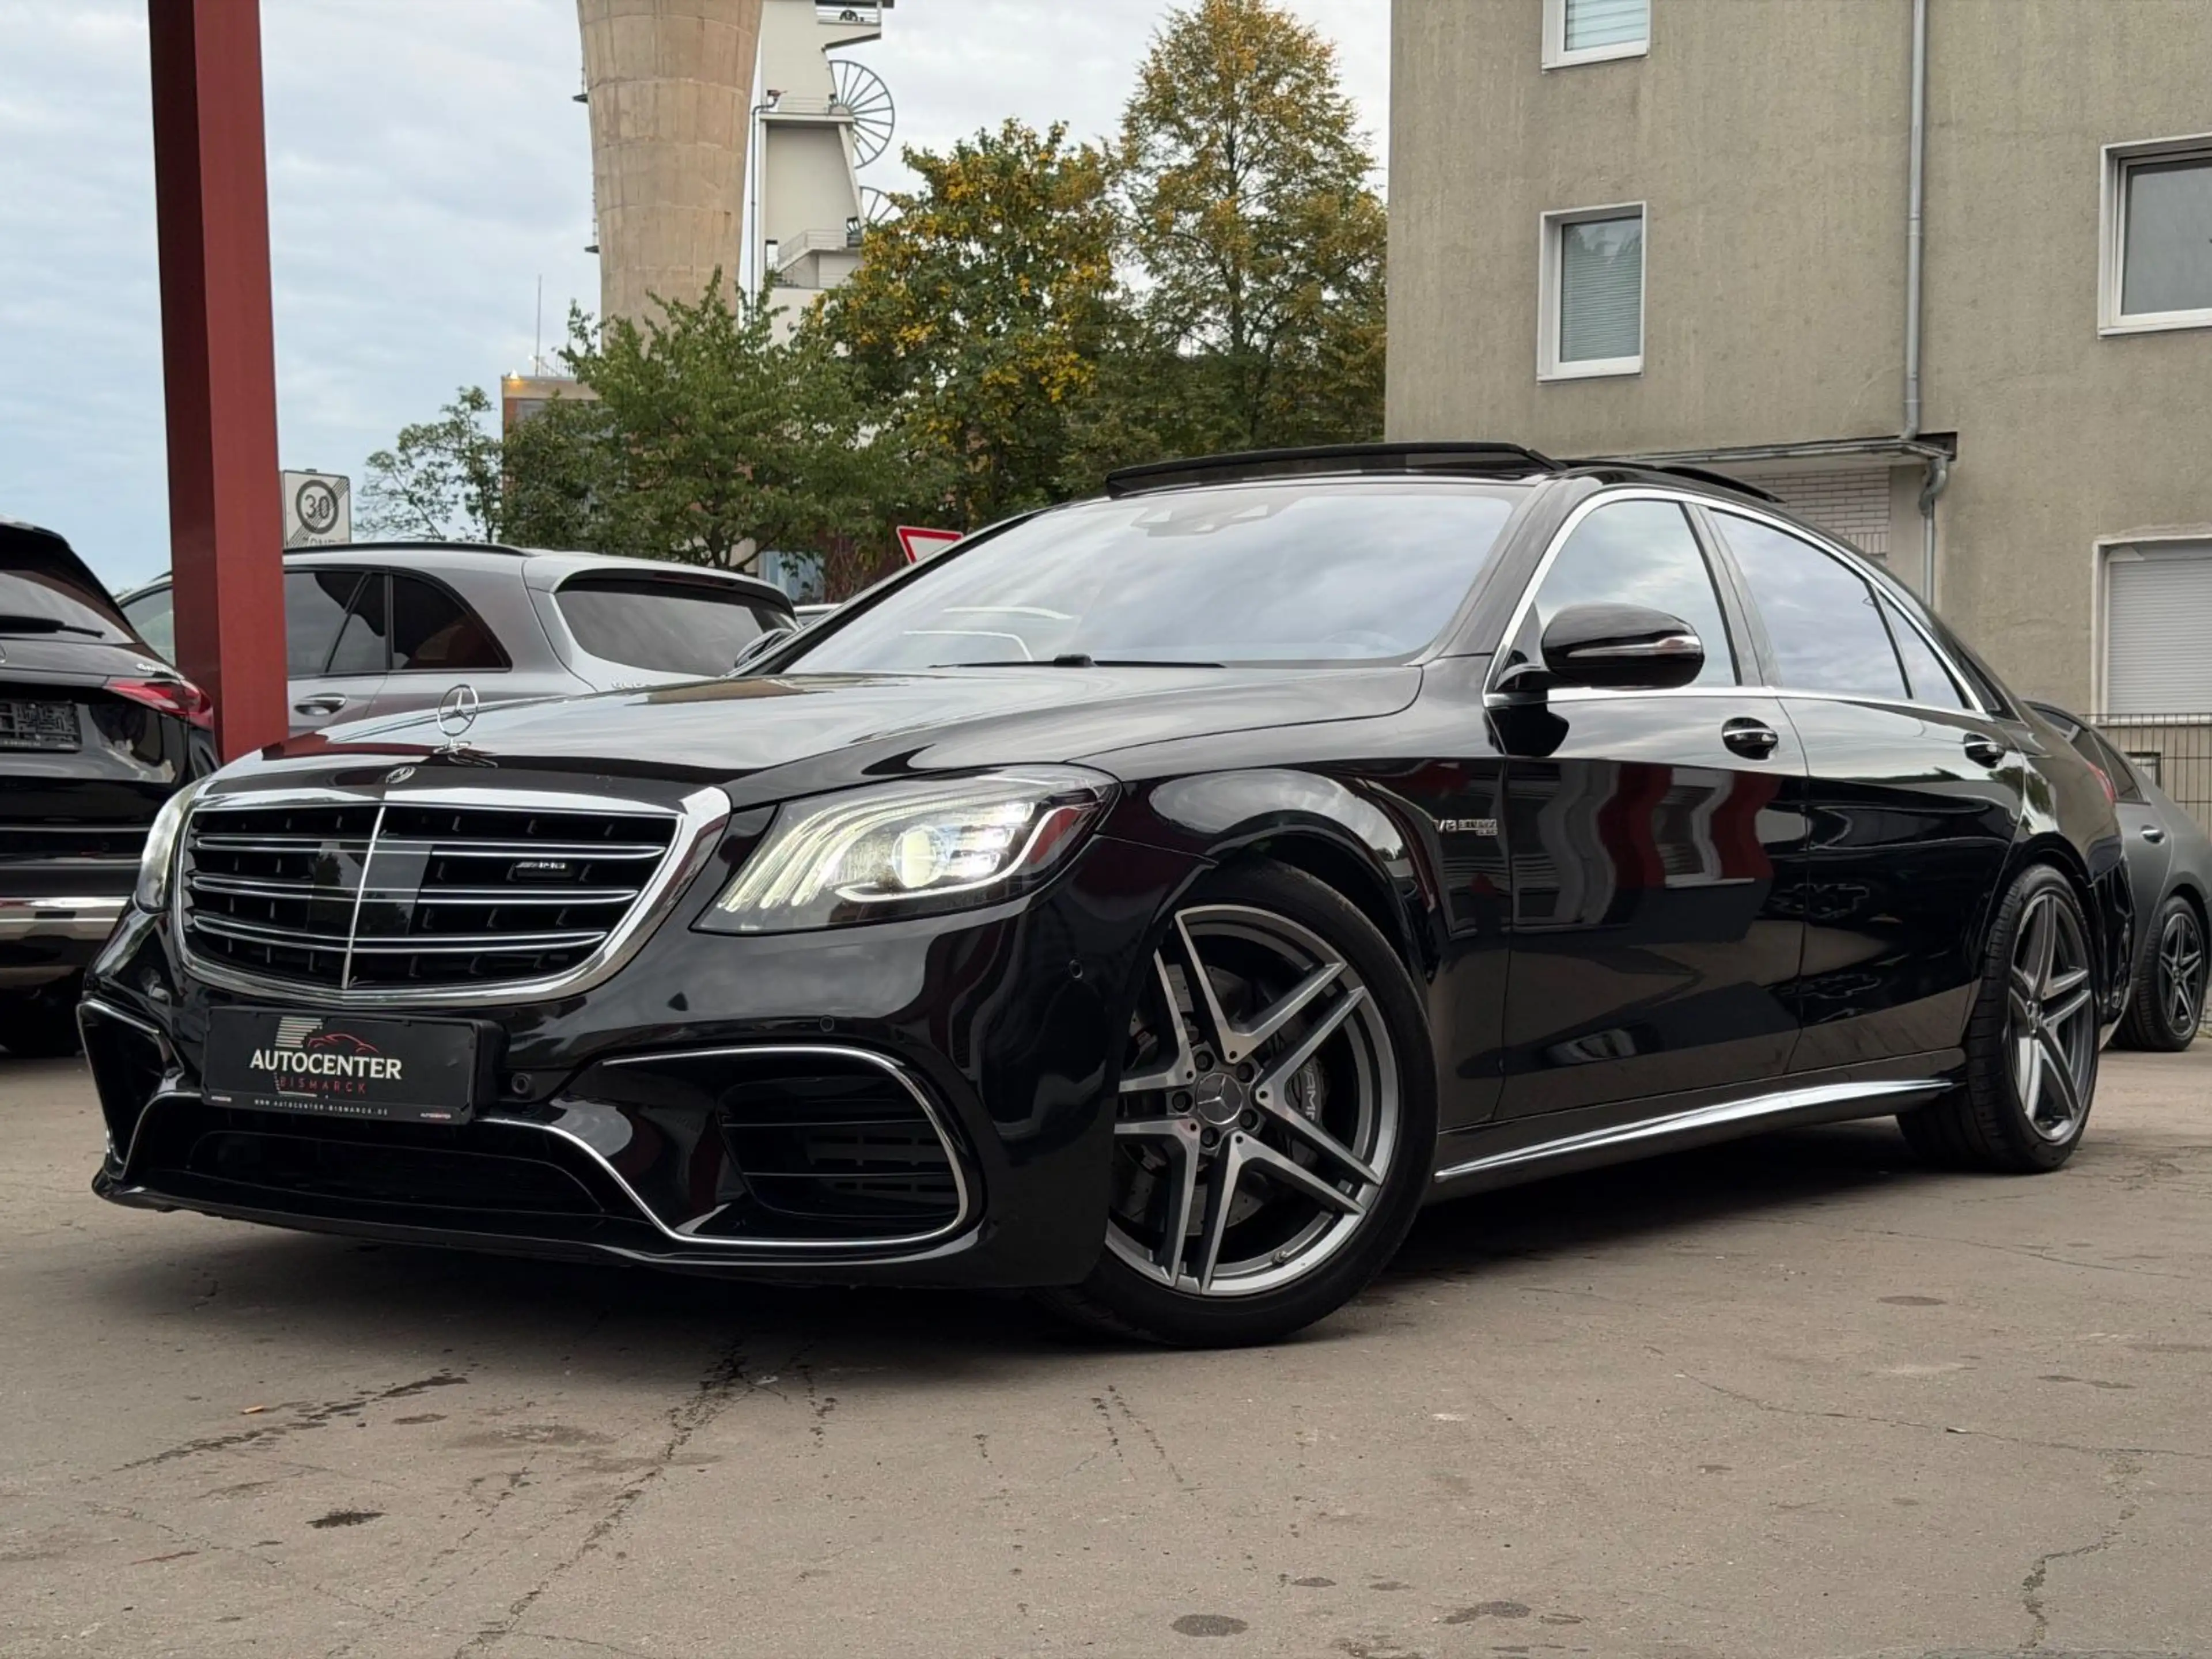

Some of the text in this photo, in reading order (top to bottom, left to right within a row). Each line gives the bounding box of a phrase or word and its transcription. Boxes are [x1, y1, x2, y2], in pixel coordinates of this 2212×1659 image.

[305, 494, 330, 519] 30
[249, 1048, 403, 1080] AUTOCENTER
[280, 1075, 367, 1094] BISMARCK
